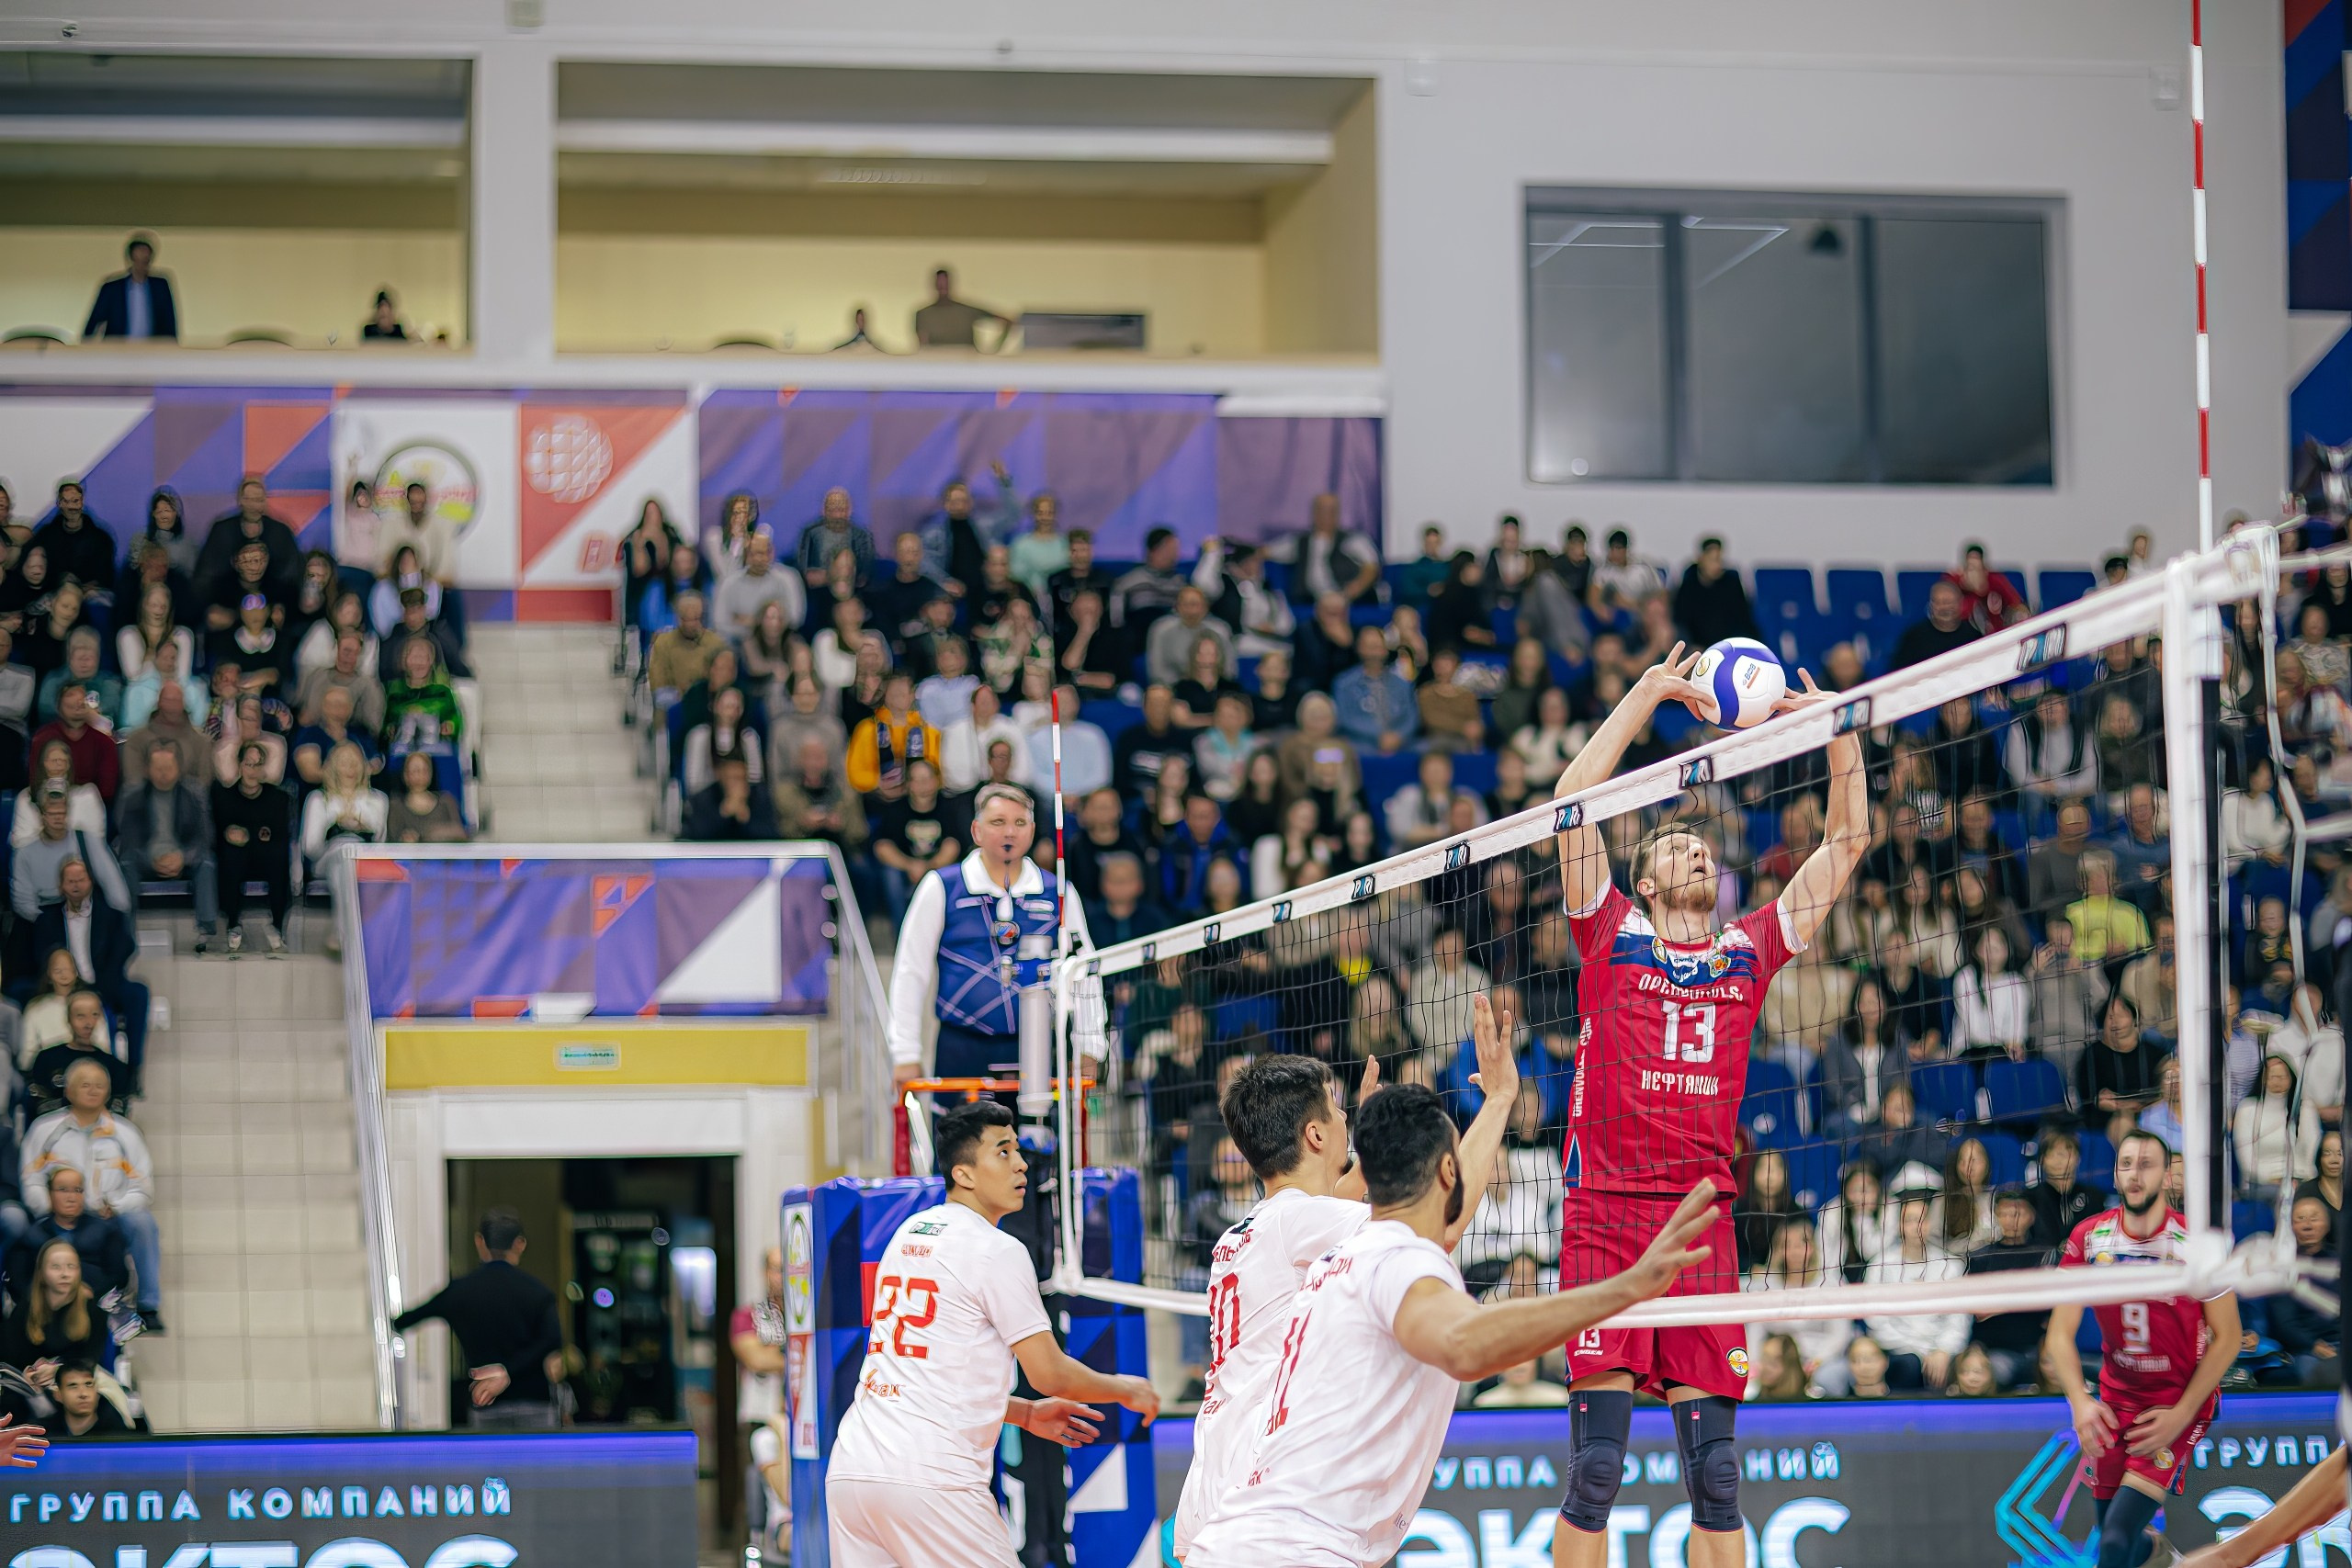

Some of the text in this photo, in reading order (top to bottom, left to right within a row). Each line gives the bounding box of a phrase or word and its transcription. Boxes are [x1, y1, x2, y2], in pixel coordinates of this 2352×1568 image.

[1555, 806, 1580, 830] PARI
[1661, 1000, 1716, 1064] 13
[1641, 1069, 1719, 1097] НЕФТЯНИК
[867, 1275, 940, 1359] 22
[2120, 1302, 2151, 1353] 9
[1578, 1328, 1600, 1348] 13
[1265, 1307, 1313, 1436] 11
[1432, 1454, 1558, 1490] УППА
[2194, 1436, 2346, 1470] ГРУПП
[9, 1477, 511, 1523] ГРУППА КОМПАНИЙ
